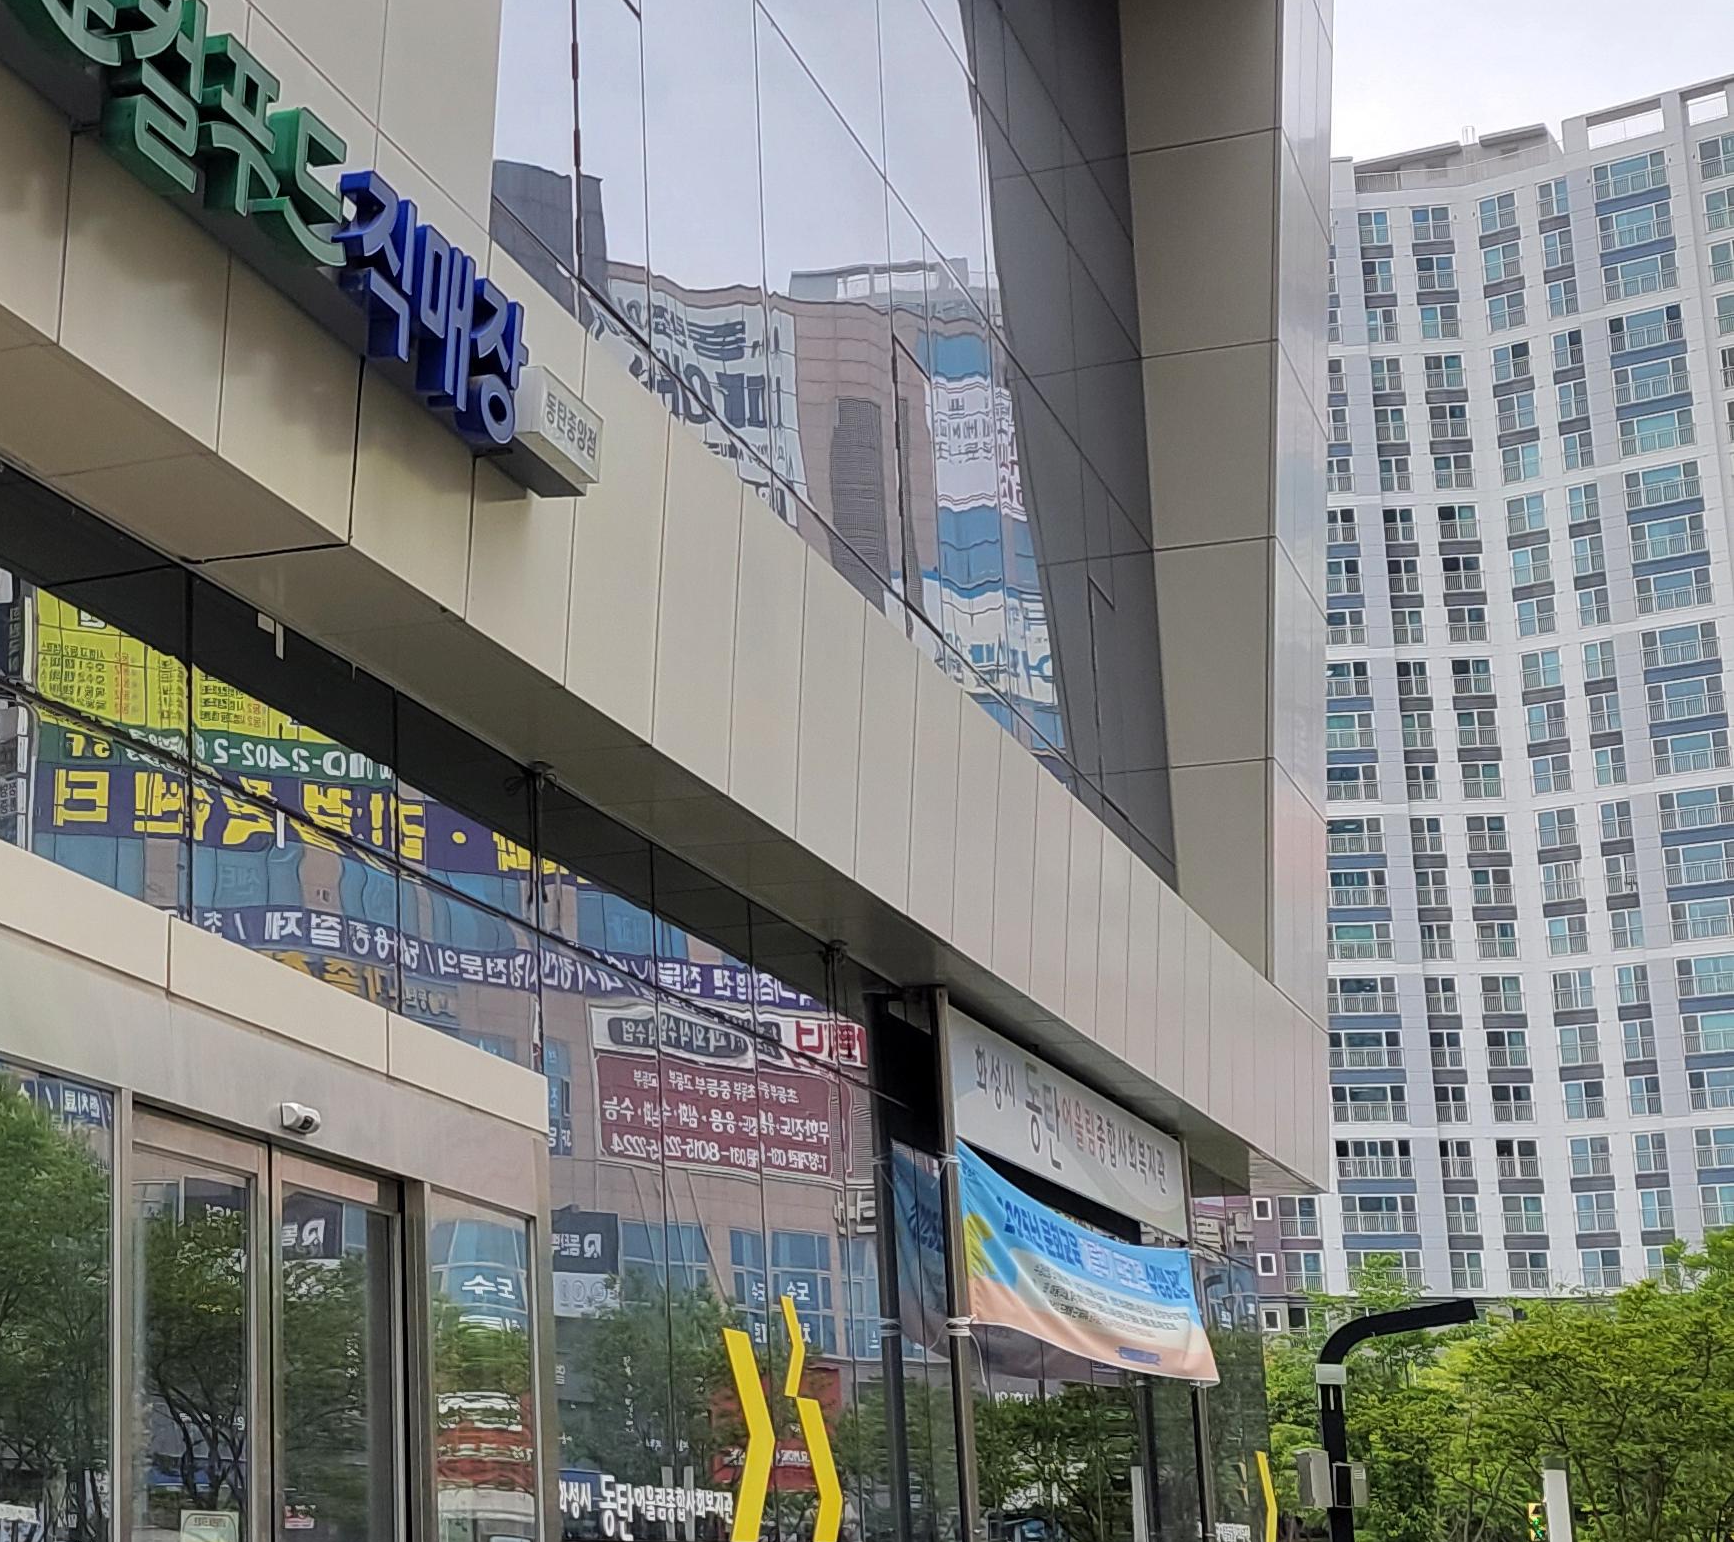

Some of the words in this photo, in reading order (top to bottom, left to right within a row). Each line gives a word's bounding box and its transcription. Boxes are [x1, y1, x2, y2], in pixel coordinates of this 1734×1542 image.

[332, 170, 529, 446] 직매장
[546, 391, 598, 461] 동탄중앙점
[975, 1044, 1016, 1110] 화성시
